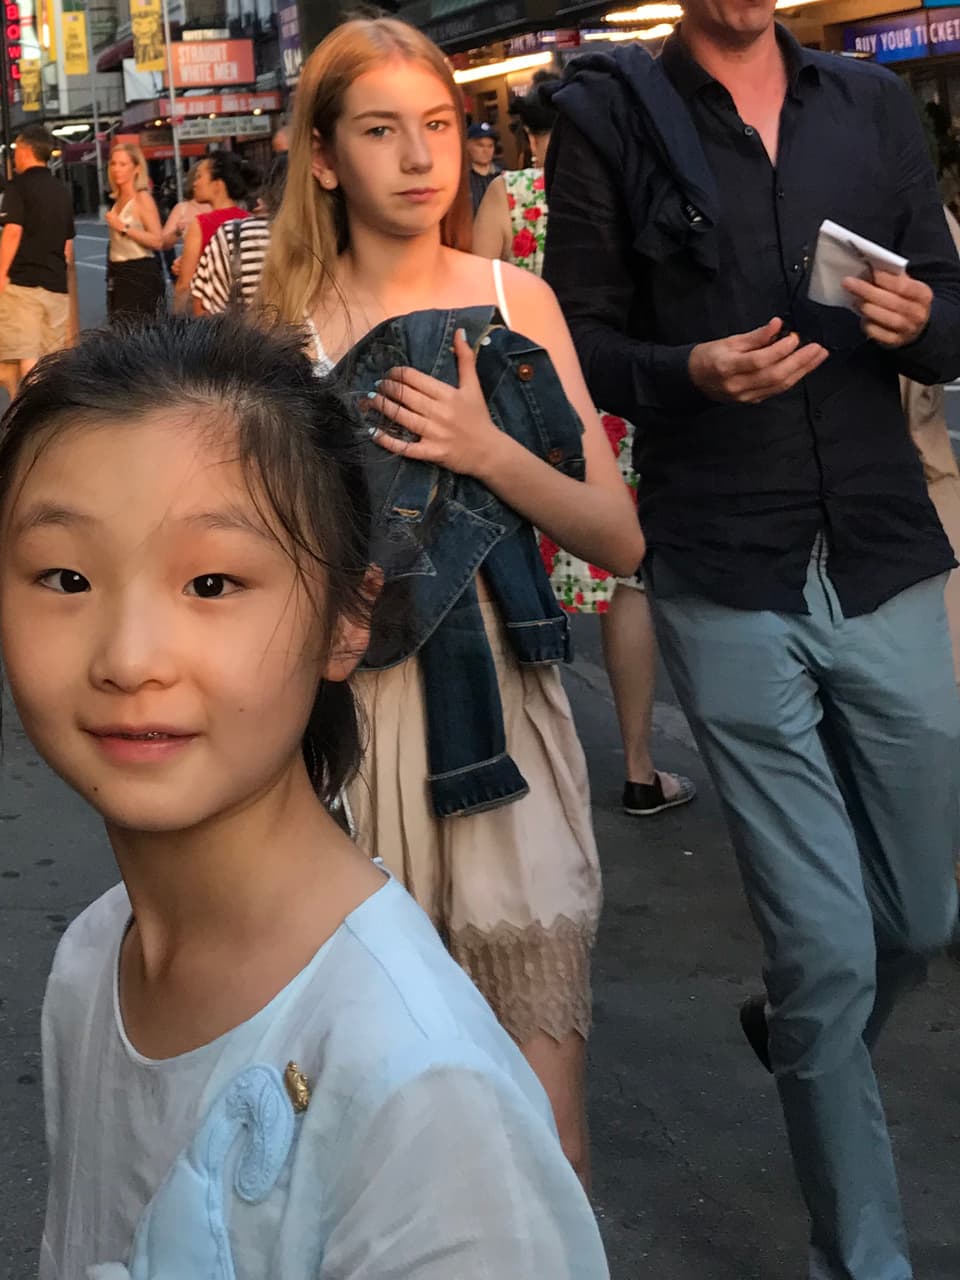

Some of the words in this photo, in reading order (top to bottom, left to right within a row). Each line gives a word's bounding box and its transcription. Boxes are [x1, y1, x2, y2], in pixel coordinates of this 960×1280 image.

[6, 3, 22, 81] BOWL
[177, 42, 227, 63] STRAIGHT
[854, 33, 877, 54] BUY
[880, 27, 913, 51] YOUR
[179, 62, 211, 83] WHITE
[213, 61, 238, 81] MEN
